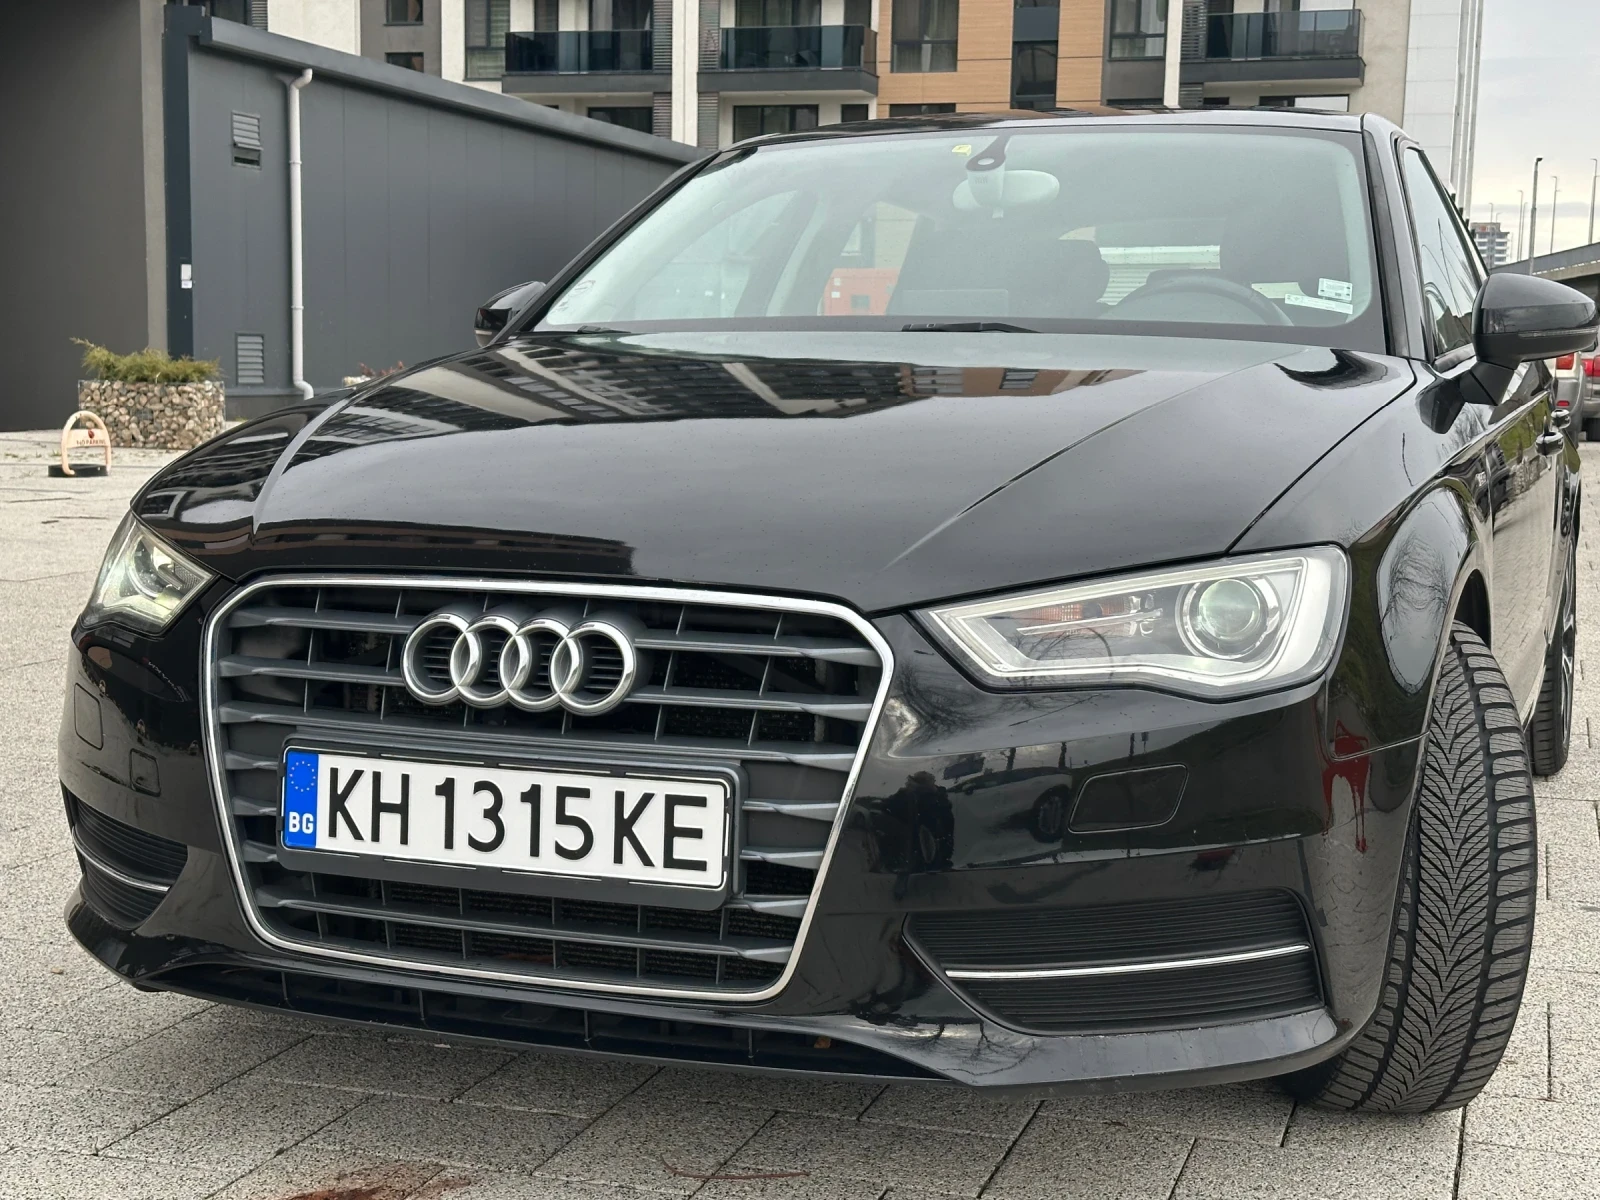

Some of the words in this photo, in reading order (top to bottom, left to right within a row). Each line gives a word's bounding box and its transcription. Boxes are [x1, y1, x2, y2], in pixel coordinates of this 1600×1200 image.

[288, 812, 314, 834] BG
[328, 767, 410, 846] KH
[435, 777, 594, 861] 1315
[613, 790, 708, 872] KE
